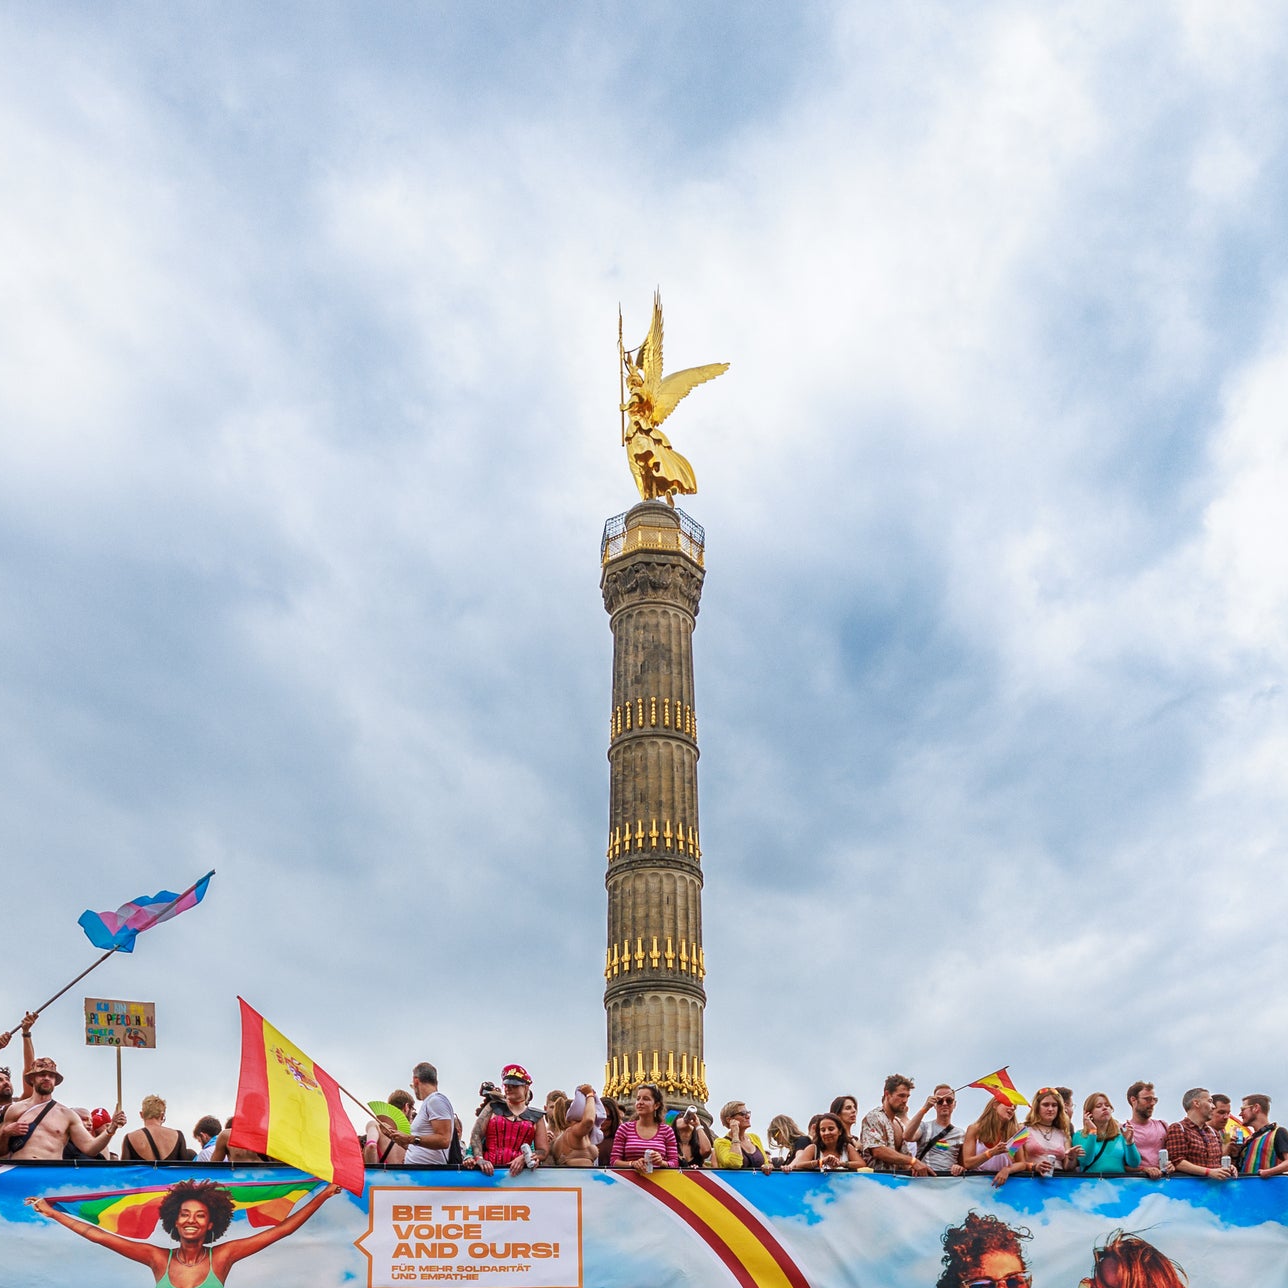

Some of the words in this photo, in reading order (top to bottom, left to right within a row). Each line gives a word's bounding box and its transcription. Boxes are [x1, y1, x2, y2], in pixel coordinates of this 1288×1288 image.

[392, 1205, 432, 1221] BE
[442, 1205, 530, 1221] THEIR
[392, 1224, 482, 1240] VOICE
[392, 1242, 458, 1259] AND
[468, 1242, 560, 1259] OURS!
[392, 1263, 415, 1272] FÜR
[456, 1263, 531, 1272] SOLIDARITÄT
